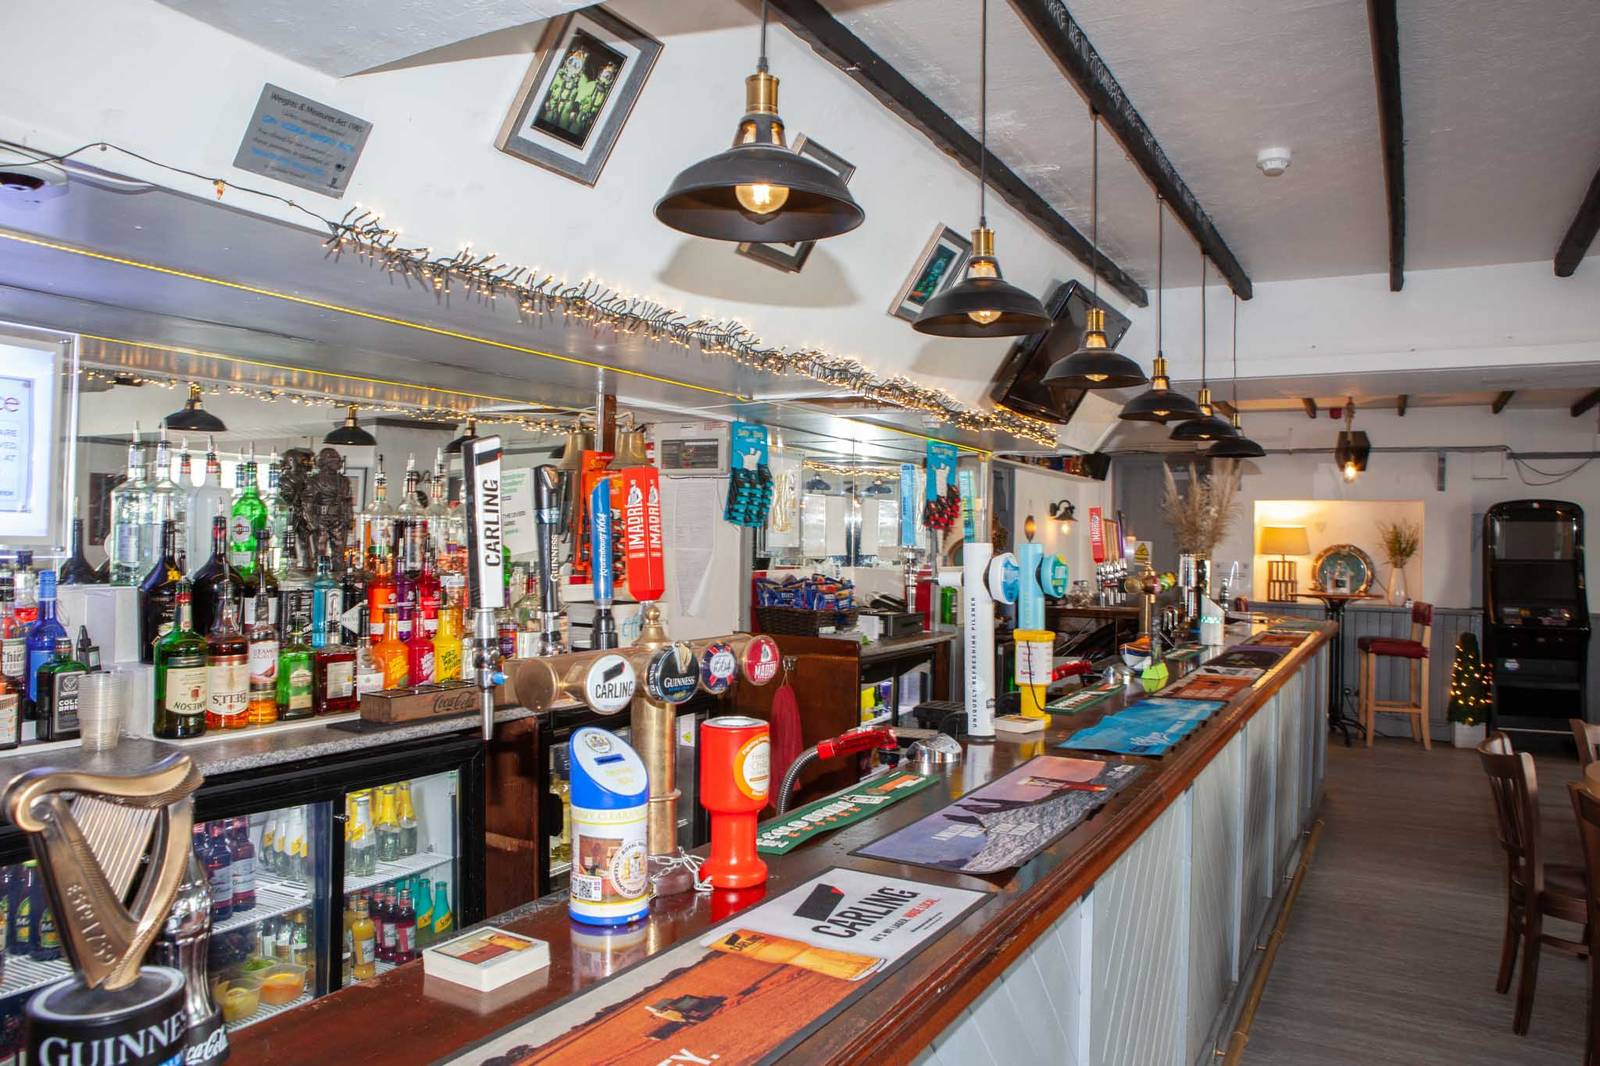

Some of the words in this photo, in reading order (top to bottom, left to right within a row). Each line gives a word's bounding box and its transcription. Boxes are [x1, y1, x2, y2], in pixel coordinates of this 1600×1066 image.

[271, 93, 298, 110] Weights
[304, 104, 335, 124] Measures
[482, 479, 499, 567] CARLING
[550, 534, 559, 582] GUINNESS
[595, 681, 633, 699] CARLING
[663, 675, 696, 688] GUINNESS
[212, 692, 247, 706] BELL'S
[811, 886, 921, 939] CARLING
